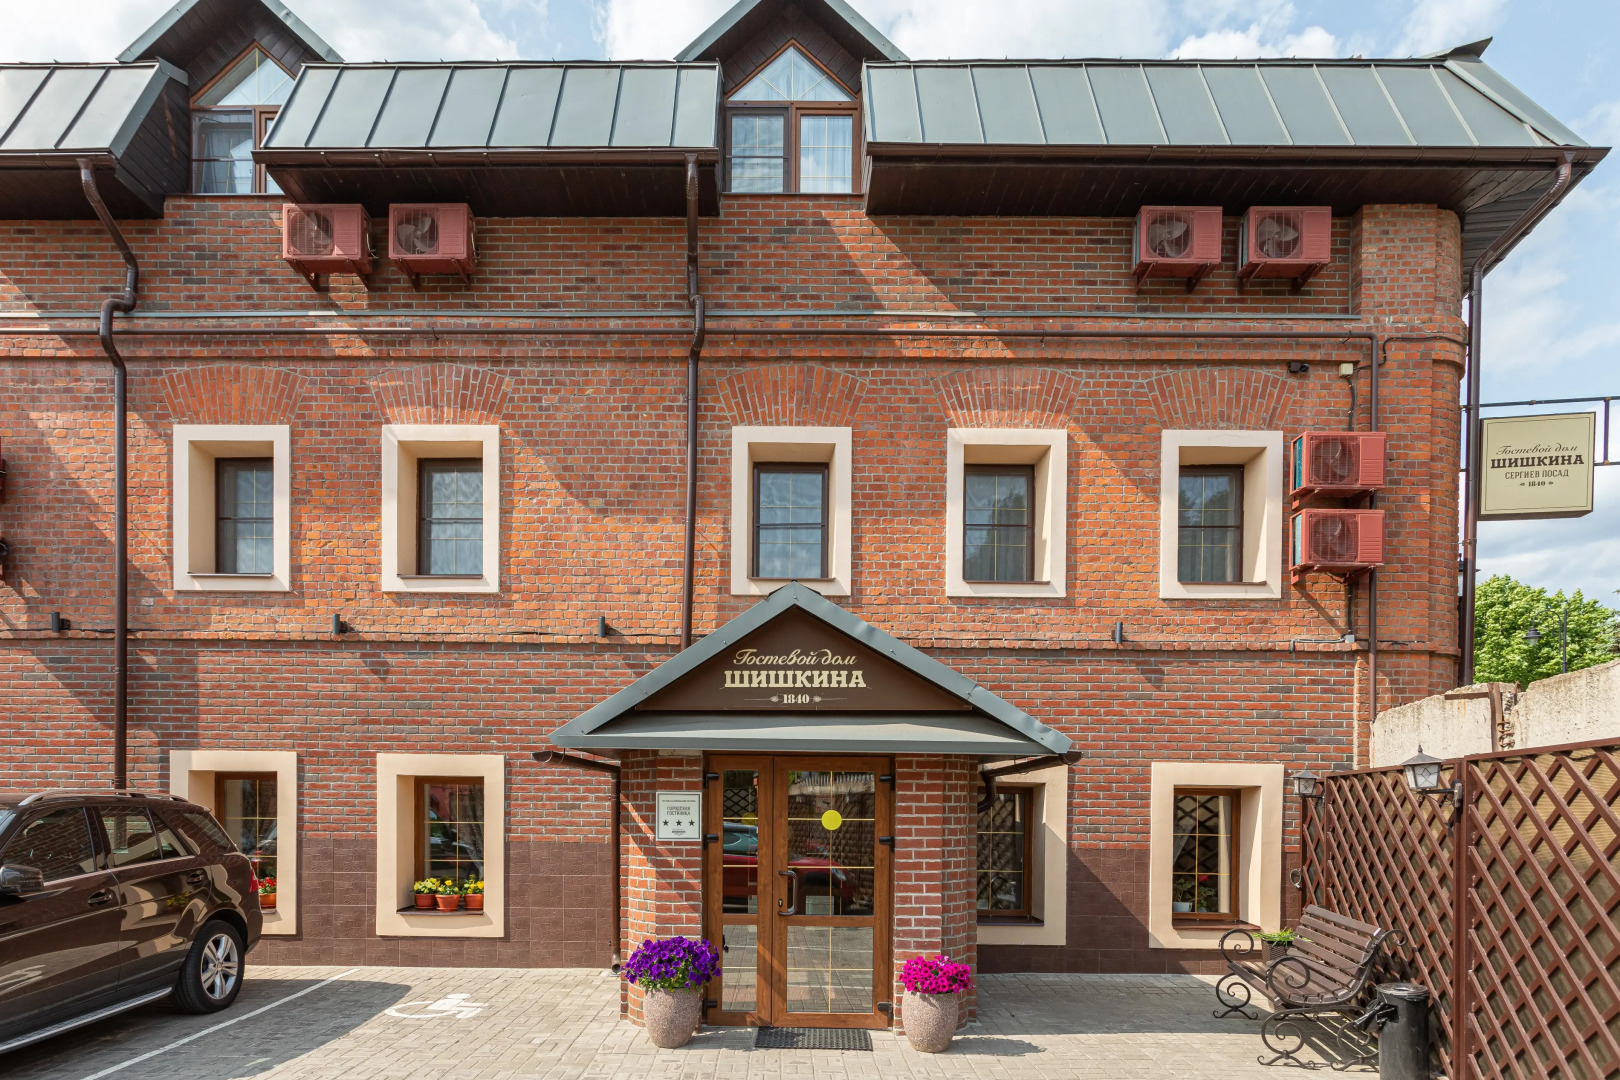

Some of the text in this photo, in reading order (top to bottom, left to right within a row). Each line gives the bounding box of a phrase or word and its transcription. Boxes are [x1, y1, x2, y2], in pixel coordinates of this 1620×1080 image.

[1496, 443, 1578, 455] Гостевой дом
[1491, 455, 1584, 469] ШИШКИНА
[1504, 469, 1569, 480] СЕРГИЕВ ПОСАД
[734, 648, 857, 665] Гостевой дом
[725, 671, 866, 687] ШИШКИНА
[782, 694, 810, 704] 1840
